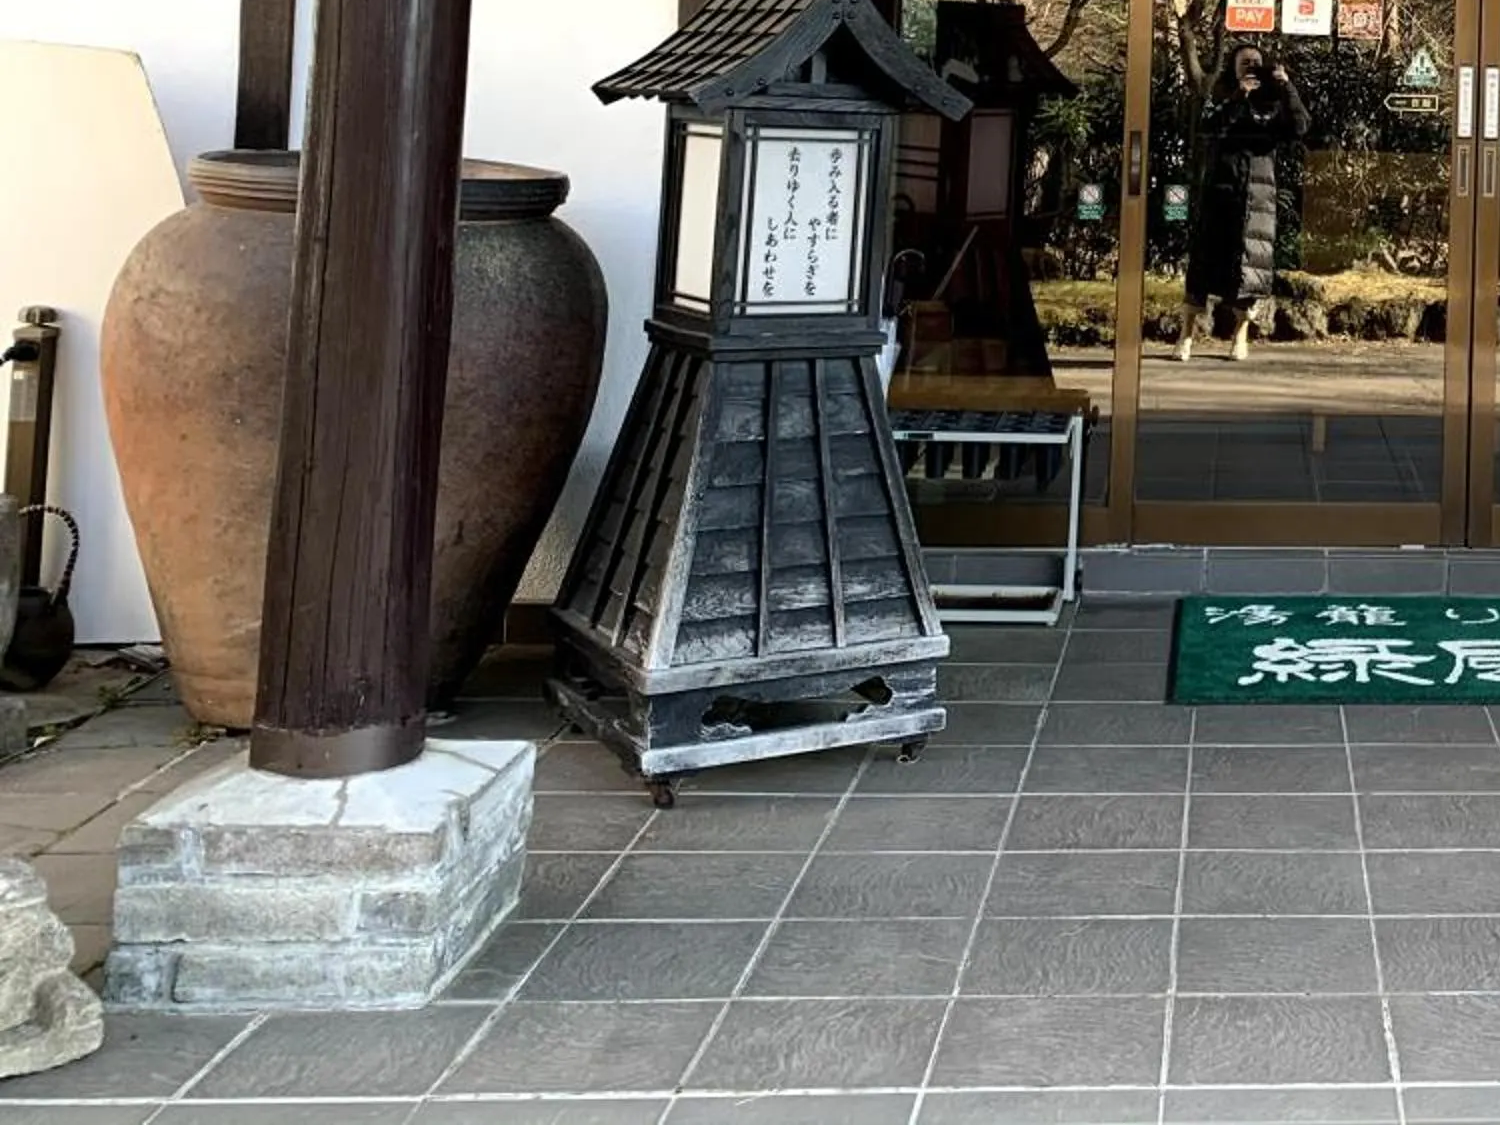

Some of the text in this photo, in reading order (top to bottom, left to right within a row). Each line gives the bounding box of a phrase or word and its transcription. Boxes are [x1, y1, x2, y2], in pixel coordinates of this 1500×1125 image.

[1235, 10, 1265, 24] PAY
[783, 146, 801, 240] 去りゆく人に
[762, 216, 780, 297] しあわせを
[804, 216, 822, 296] やすらぎを
